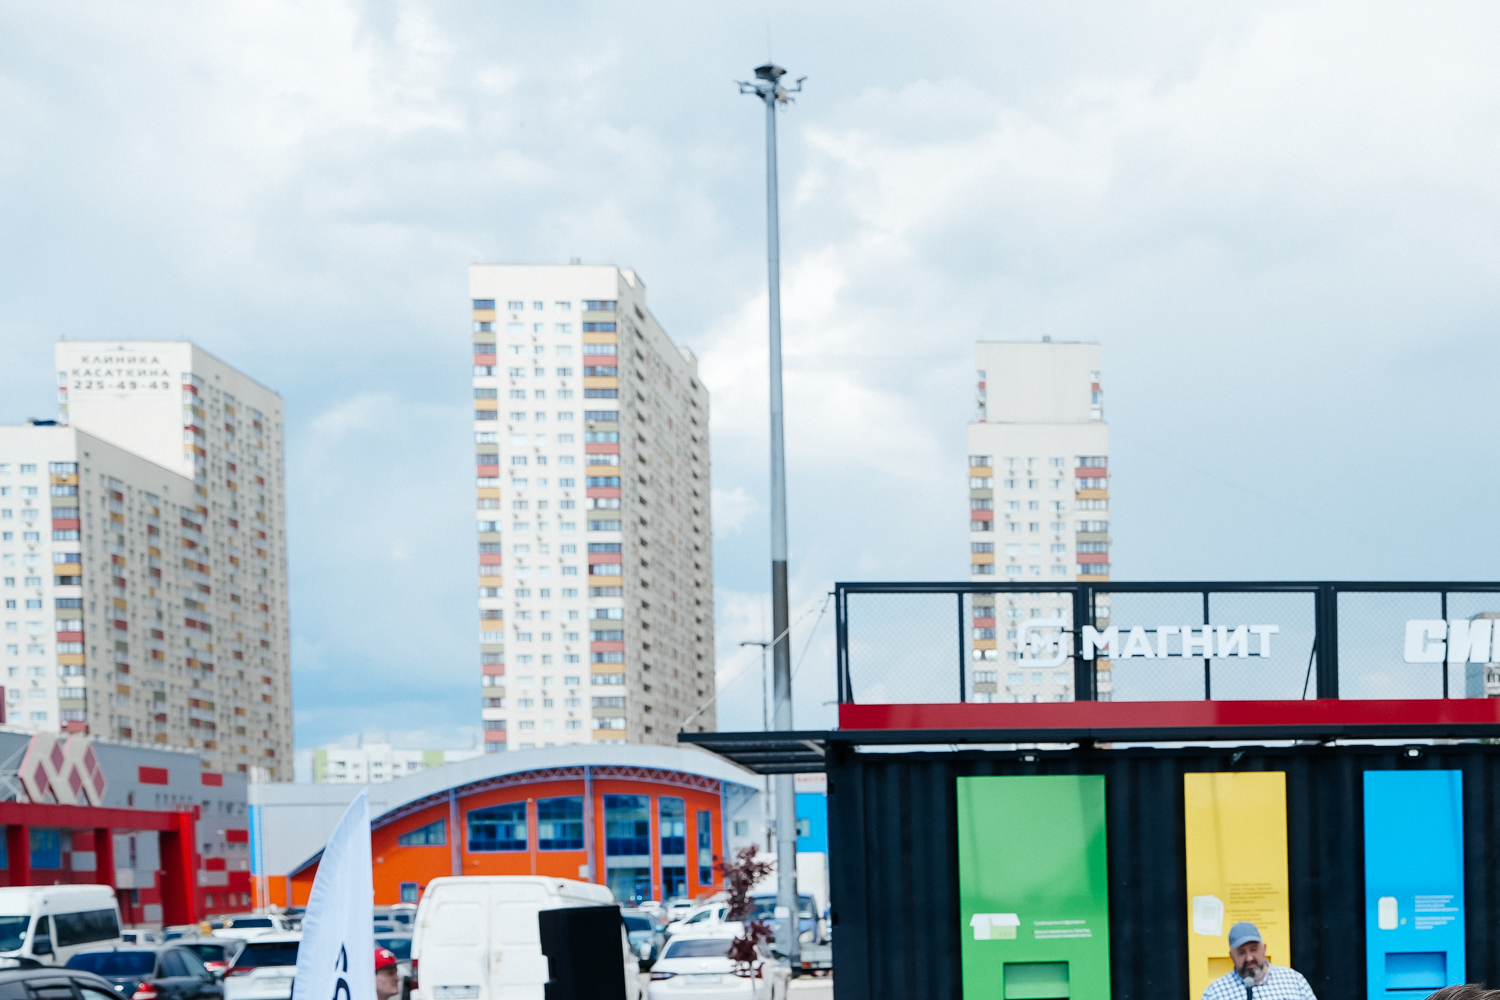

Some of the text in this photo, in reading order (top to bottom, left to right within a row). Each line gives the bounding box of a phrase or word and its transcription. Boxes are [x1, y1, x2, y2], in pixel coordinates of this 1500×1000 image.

[81, 356, 160, 364] КЛИНИКА
[72, 369, 170, 377] КАСАТКИНА
[1081, 624, 1279, 661] МАГНИТ
